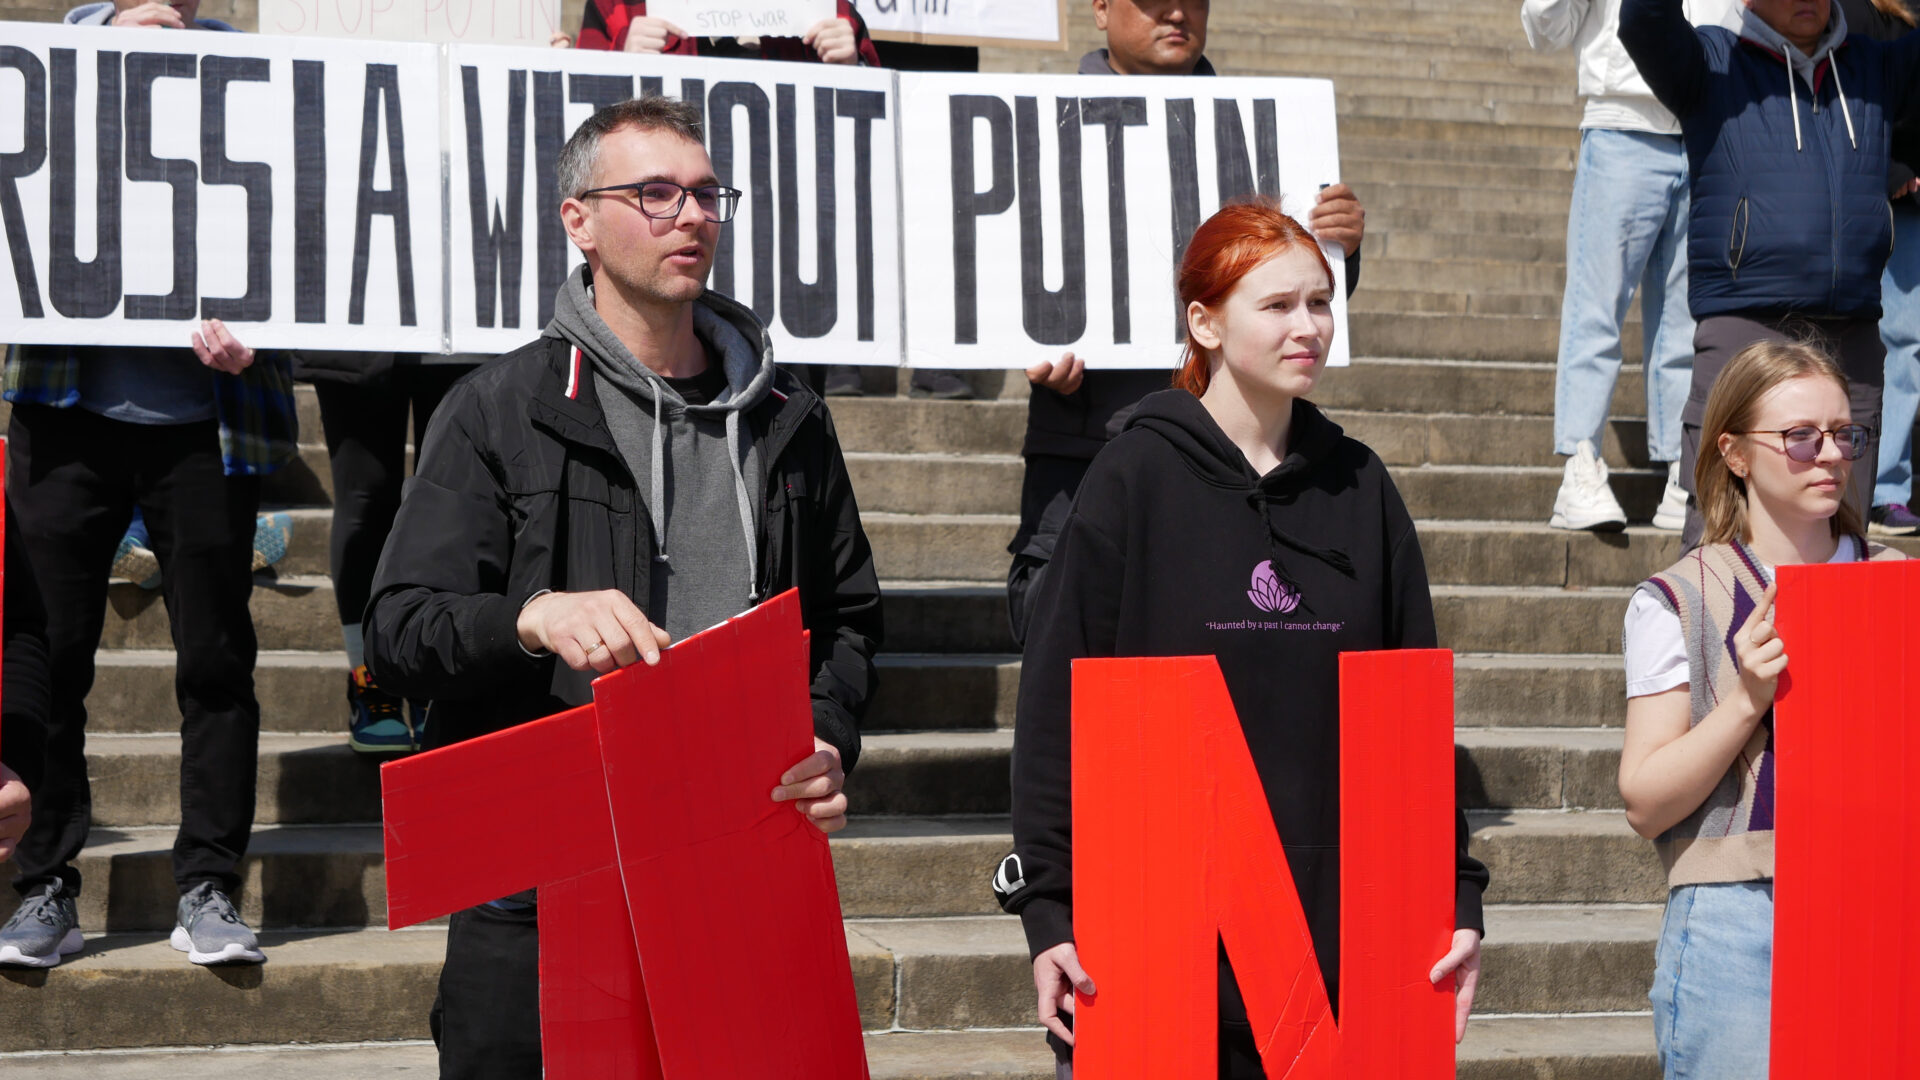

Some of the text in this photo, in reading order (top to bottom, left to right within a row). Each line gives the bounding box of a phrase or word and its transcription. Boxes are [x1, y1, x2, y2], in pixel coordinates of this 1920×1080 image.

[697, 9, 742, 30] STOP
[0, 45, 418, 326] RUSSIA
[460, 64, 886, 342] WIOUT
[1247, 620, 1257, 631] by
[1264, 621, 1279, 631] past
[1284, 622, 1311, 631] cannot
